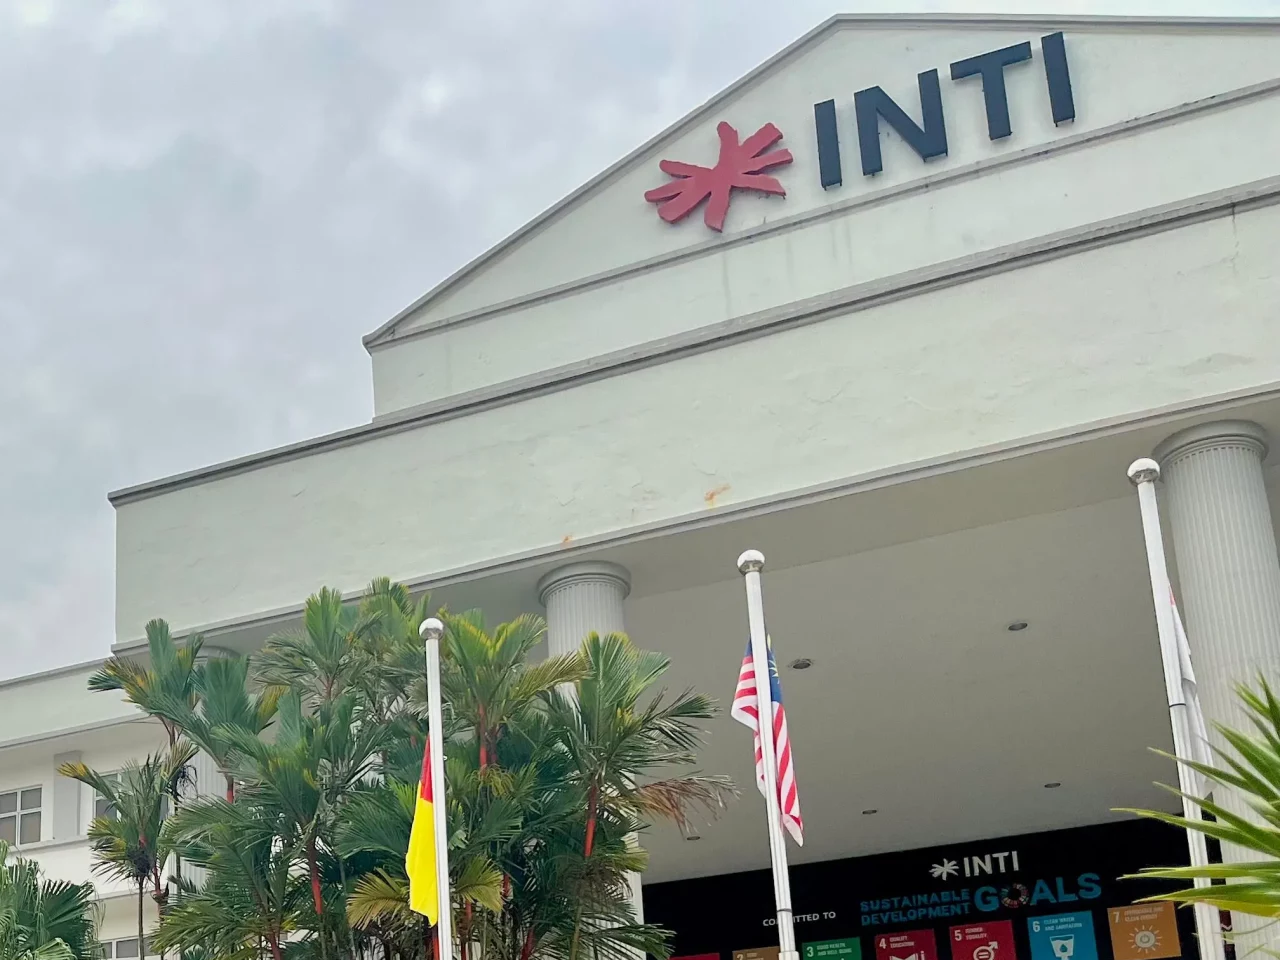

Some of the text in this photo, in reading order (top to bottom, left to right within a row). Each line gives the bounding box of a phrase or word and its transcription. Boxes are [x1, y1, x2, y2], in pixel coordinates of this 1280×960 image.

[814, 31, 1076, 189] INTI
[964, 851, 1020, 877] INTI
[860, 889, 970, 912] SUSTAINABLE
[762, 911, 836, 927] COITTED TO
[861, 903, 971, 926] DEVELOPMENT
[1113, 911, 1120, 923] 7
[1032, 920, 1040, 932] 6
[954, 930, 962, 941] 5
[879, 938, 887, 949] 4
[807, 946, 814, 957] 3
